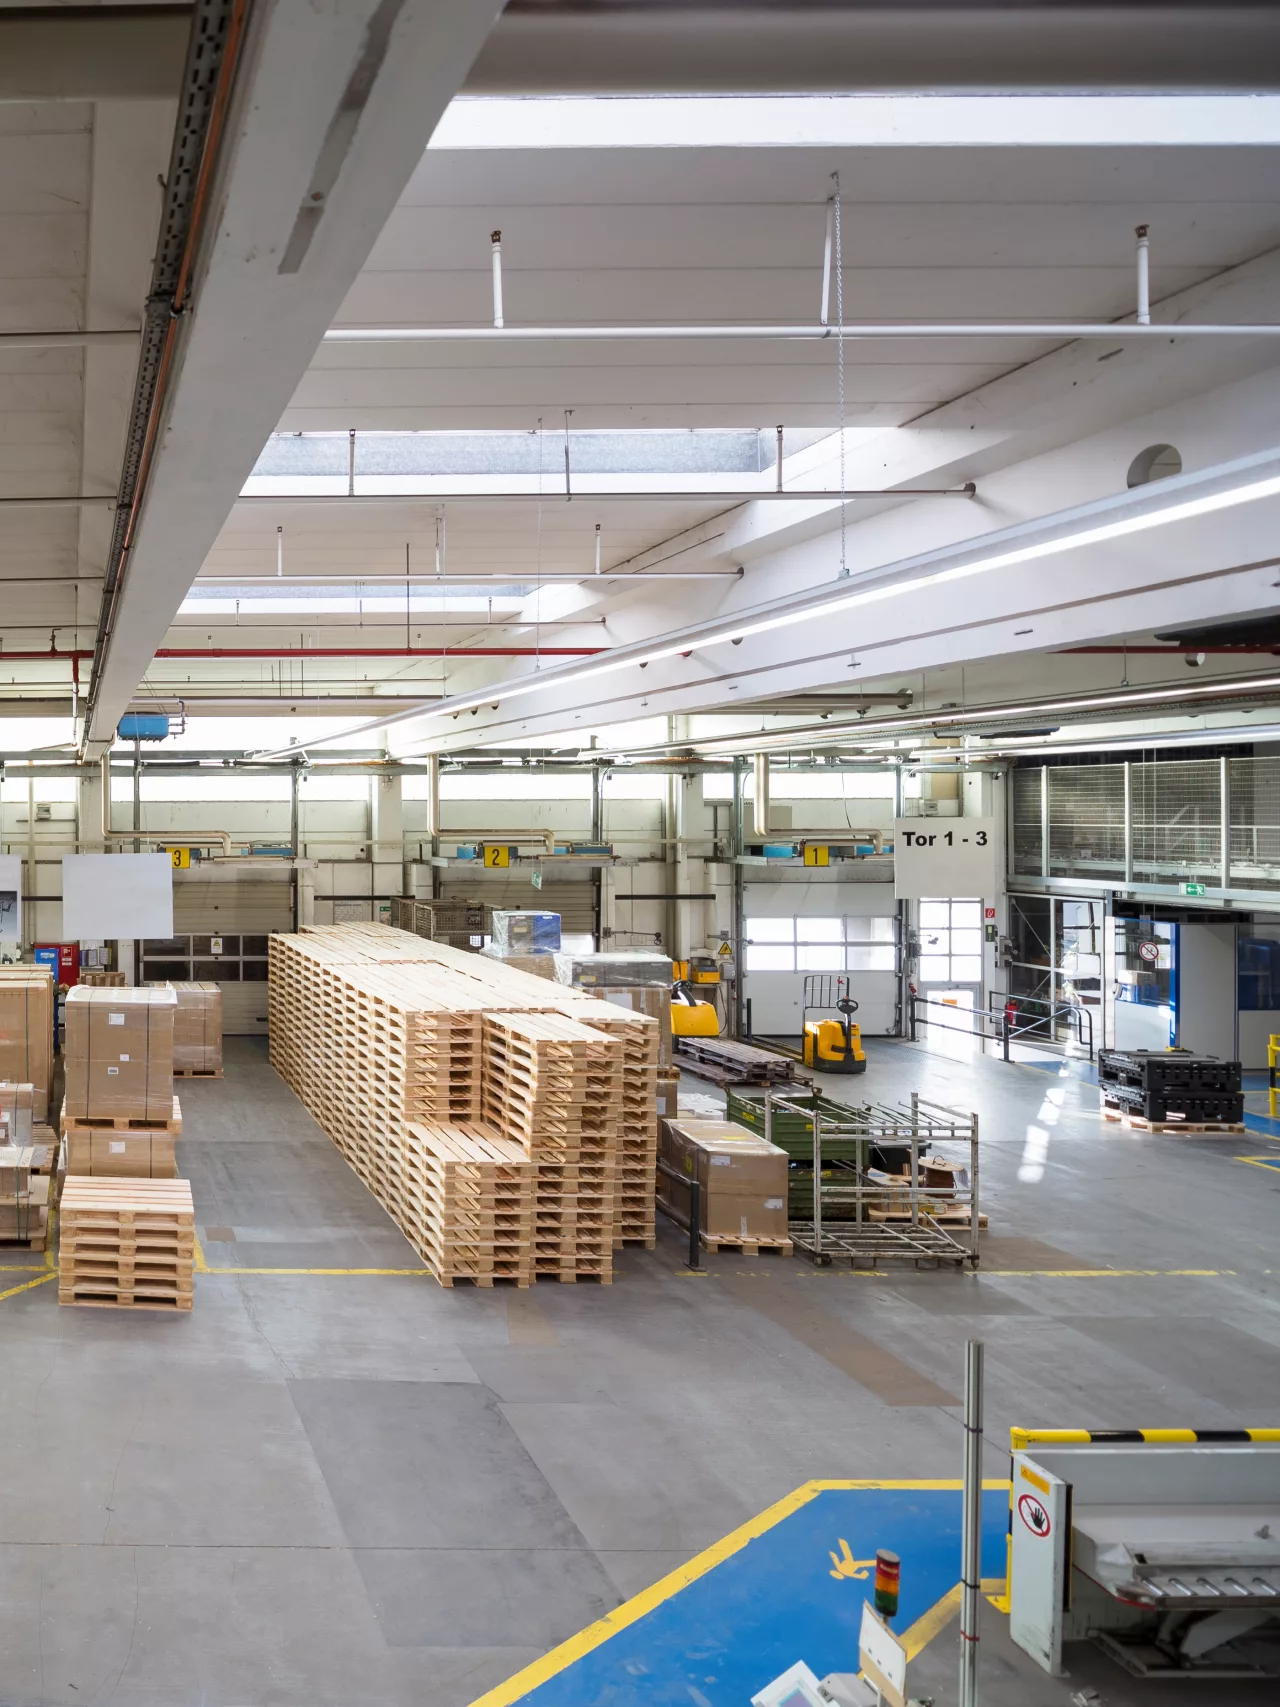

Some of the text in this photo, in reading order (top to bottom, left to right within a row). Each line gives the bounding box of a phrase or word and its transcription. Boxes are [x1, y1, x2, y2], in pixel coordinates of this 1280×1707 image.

[902, 832, 937, 847] Tor
[944, 831, 953, 846] 1
[976, 831, 988, 847] 3
[174, 850, 181, 867] 3
[492, 850, 500, 866] 2
[812, 849, 818, 865] 1
